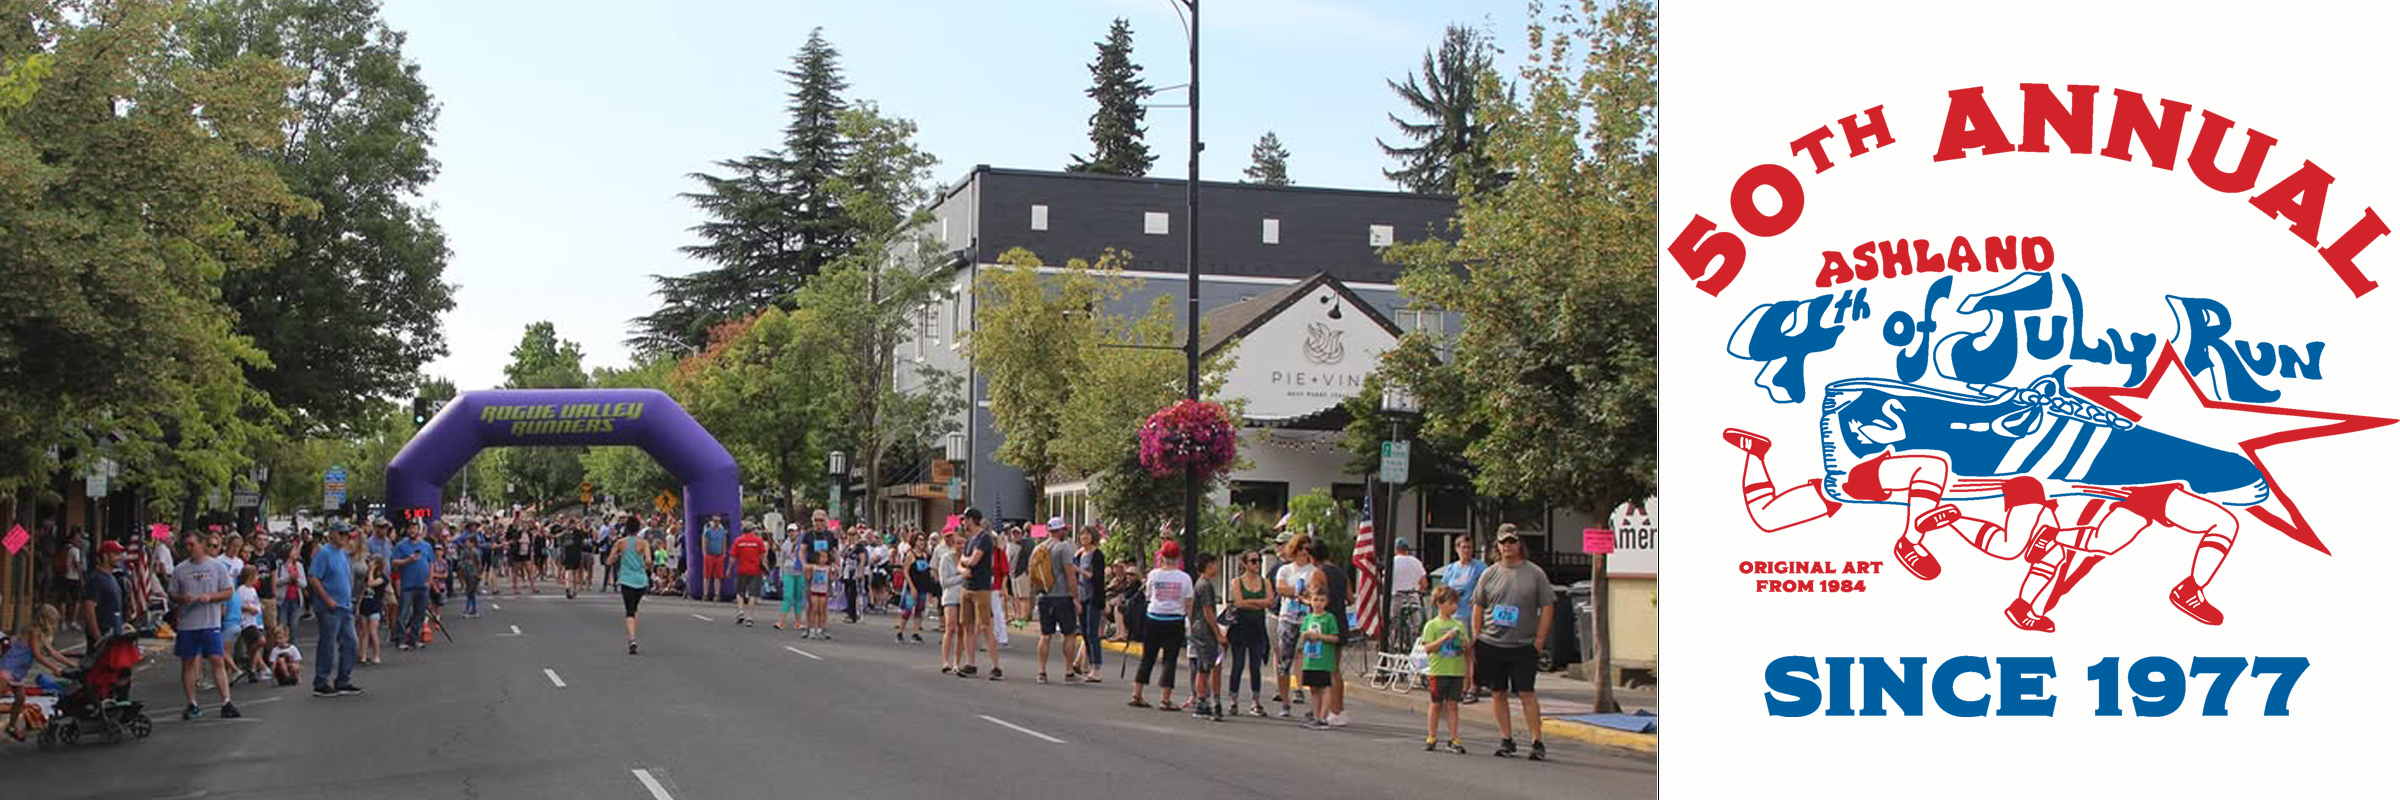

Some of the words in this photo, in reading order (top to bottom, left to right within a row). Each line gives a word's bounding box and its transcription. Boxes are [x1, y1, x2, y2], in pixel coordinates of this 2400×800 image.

[480, 404, 557, 424] ROGUE
[559, 401, 644, 420] VALLEY
[511, 418, 615, 437] RUNNERS
